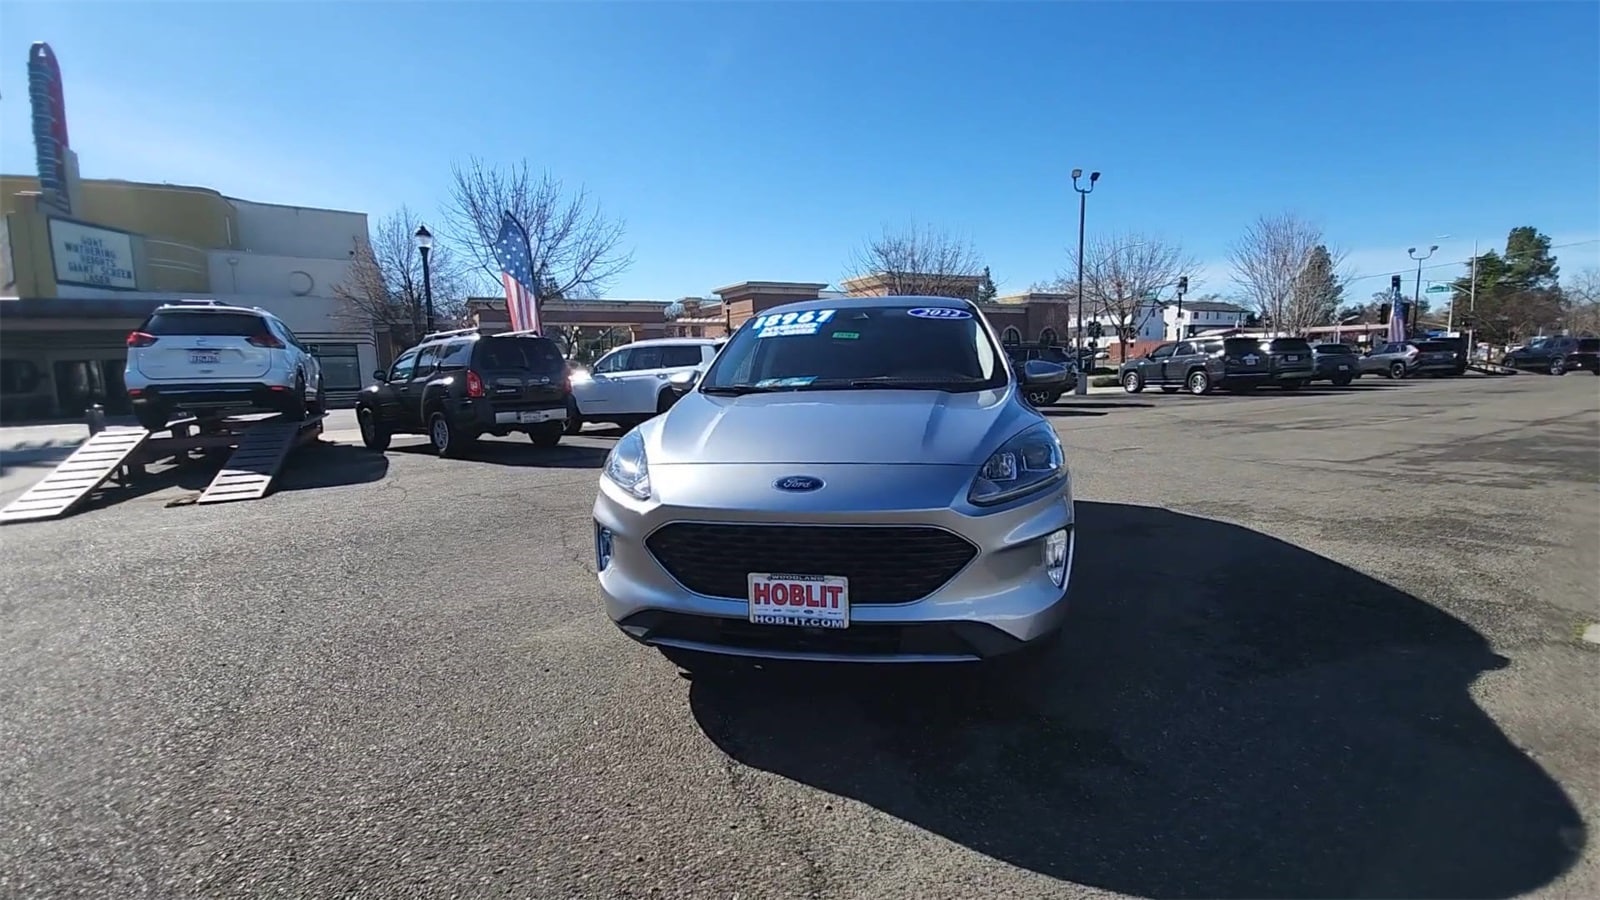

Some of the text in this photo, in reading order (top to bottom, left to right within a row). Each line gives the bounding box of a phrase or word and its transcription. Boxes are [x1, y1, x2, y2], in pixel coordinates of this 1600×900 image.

[752, 309, 837, 329] 18967
[783, 478, 812, 488] Ford
[753, 582, 843, 608] HOBLIT
[754, 615, 844, 628] HOBLIT.COM
